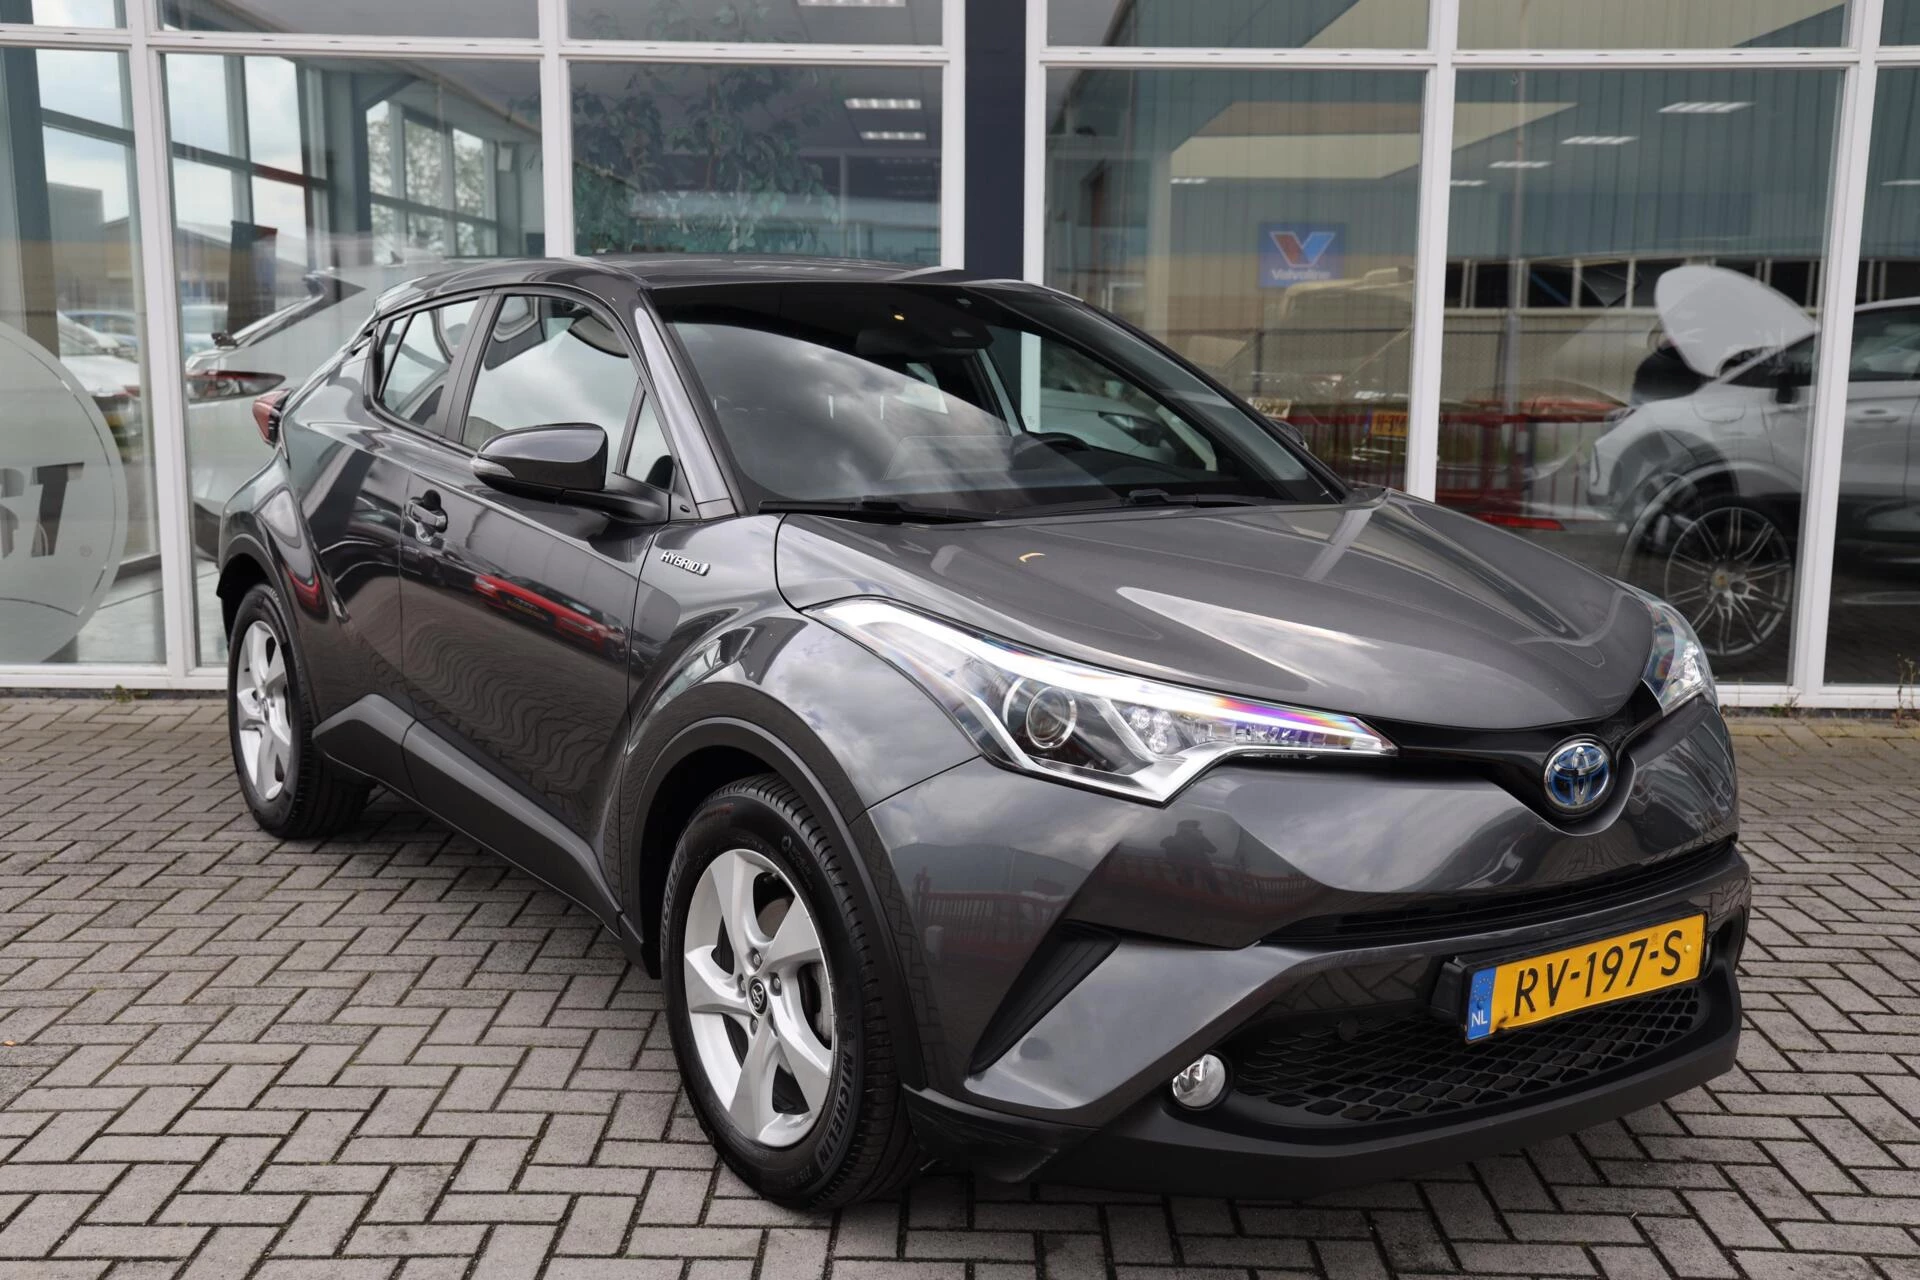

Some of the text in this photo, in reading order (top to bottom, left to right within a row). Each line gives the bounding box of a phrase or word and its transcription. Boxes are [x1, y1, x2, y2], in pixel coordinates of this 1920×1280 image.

[660, 551, 700, 573] HYBRID
[1513, 930, 1683, 1017] RV-197-S
[1471, 1010, 1488, 1027] NL
[817, 1052, 854, 1166] MICHELIN
